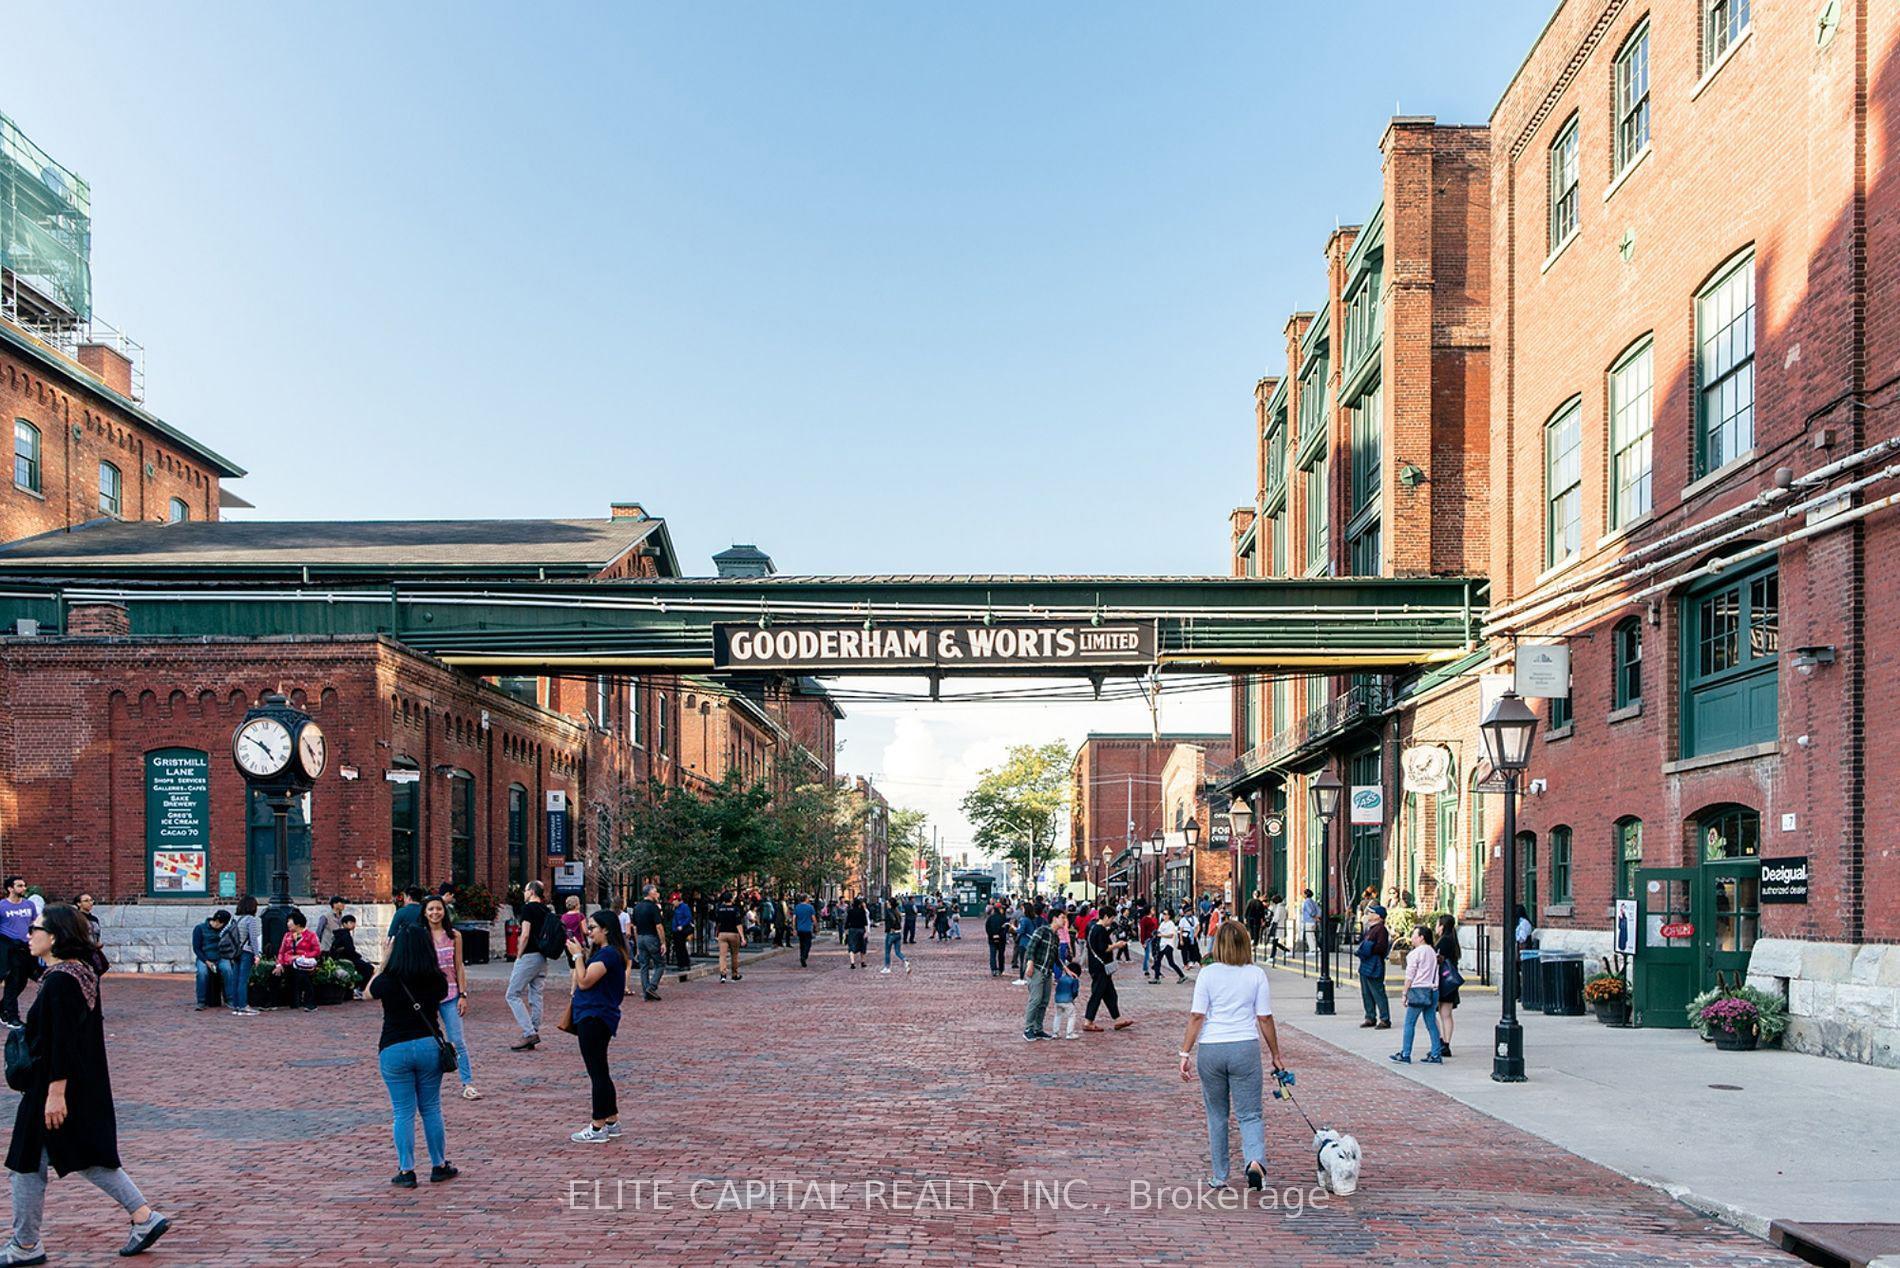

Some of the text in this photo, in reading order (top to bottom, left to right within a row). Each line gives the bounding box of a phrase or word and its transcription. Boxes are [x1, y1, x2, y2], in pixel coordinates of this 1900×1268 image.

[731, 627, 1139, 660] GOODERHAM & WORTS LIMITED
[153, 757, 207, 767] GRISTMILL
